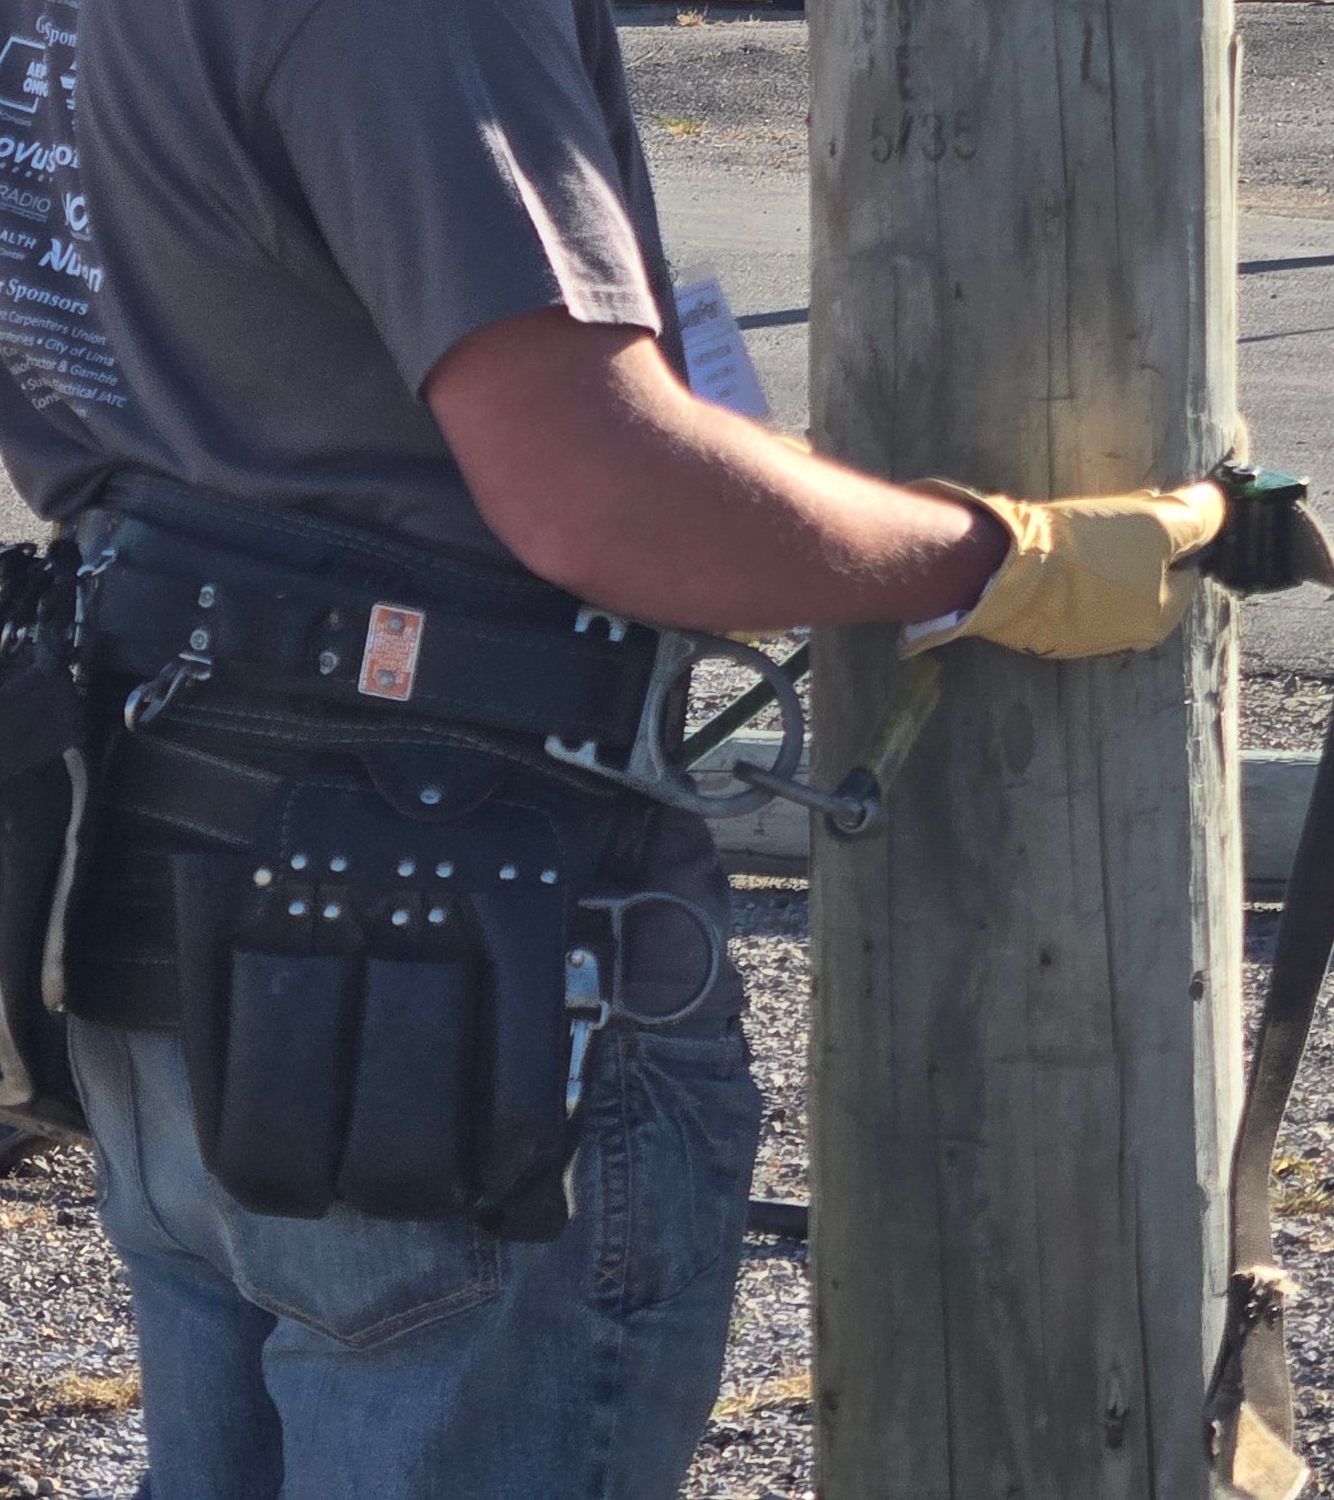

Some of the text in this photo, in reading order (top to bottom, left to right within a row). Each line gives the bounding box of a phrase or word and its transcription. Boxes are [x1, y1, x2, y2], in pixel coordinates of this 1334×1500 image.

[5, 278, 90, 316] Sponsors
[8, 311, 70, 335] Carpenters
[71, 327, 108, 347] Union
[45, 338, 68, 355] City
